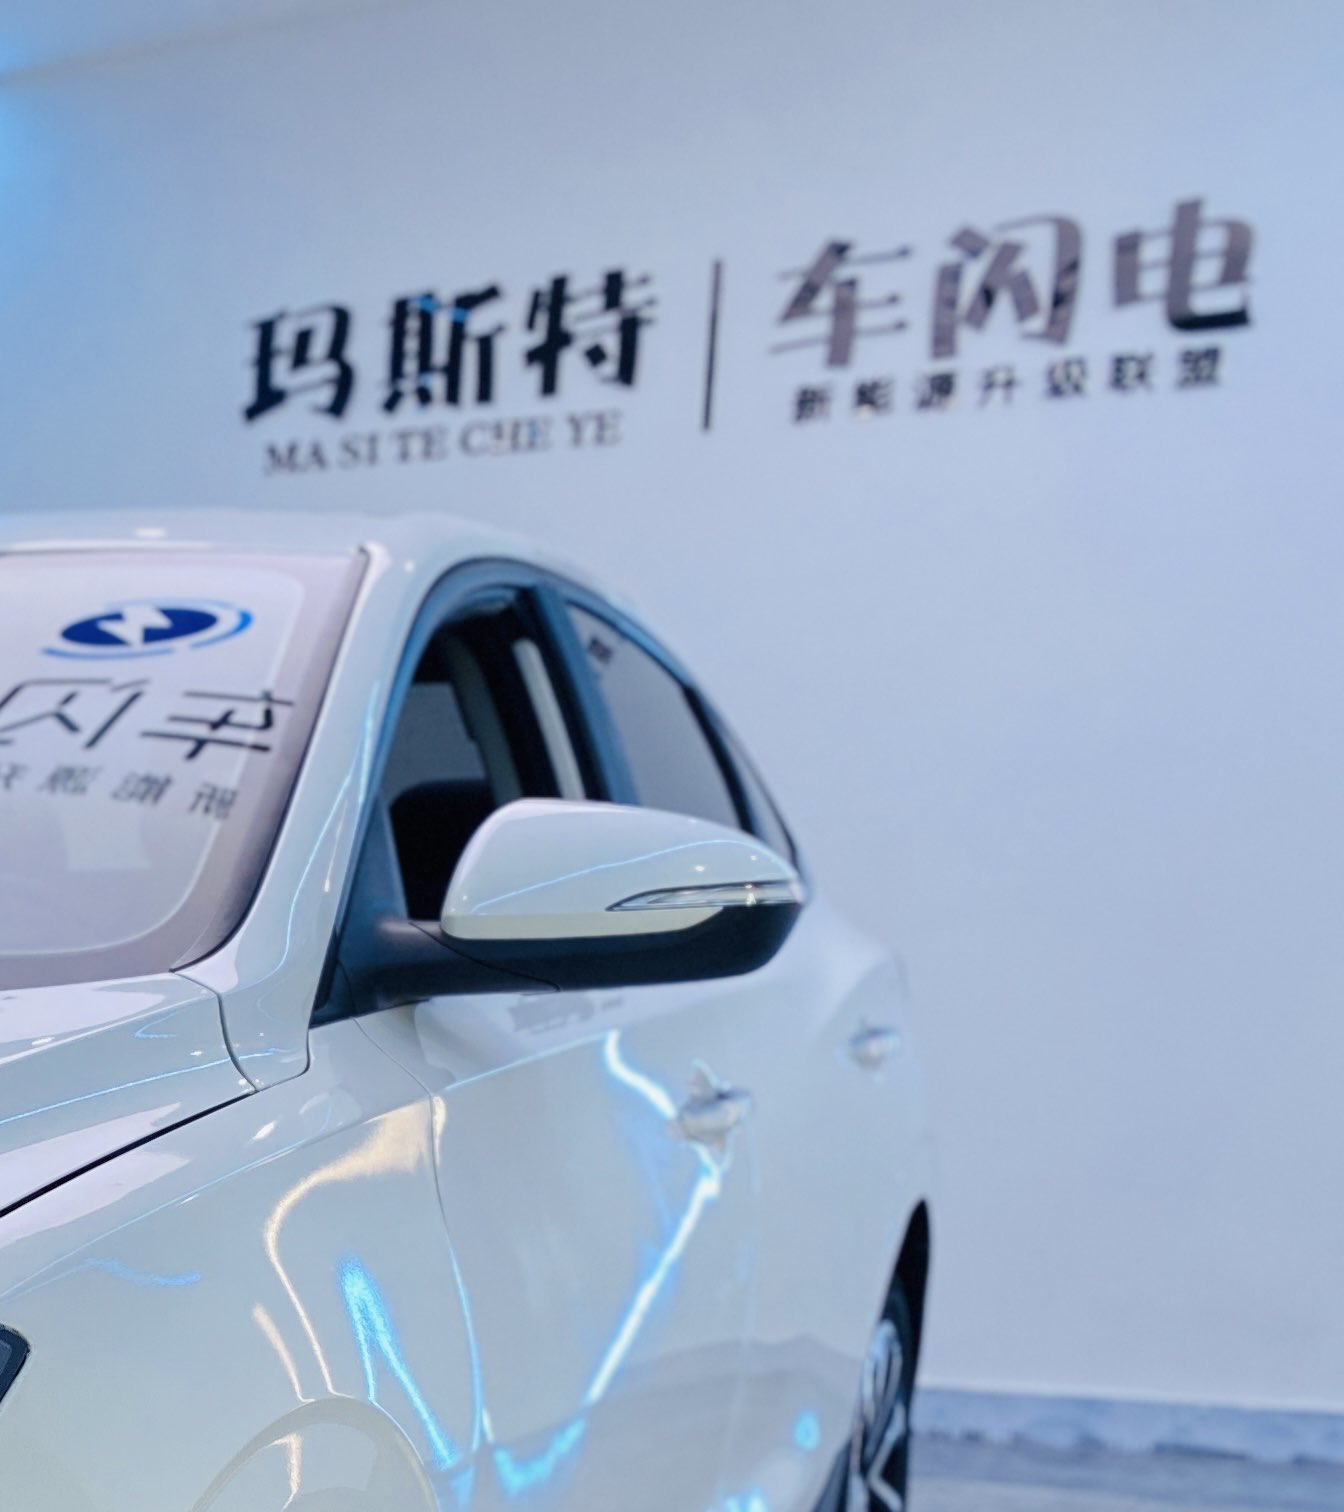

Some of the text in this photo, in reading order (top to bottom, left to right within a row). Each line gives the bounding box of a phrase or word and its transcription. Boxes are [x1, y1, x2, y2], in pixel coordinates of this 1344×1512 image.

[242, 268, 656, 422] 玛斯特
[771, 197, 1256, 368] 车闪电
[792, 345, 1224, 424] 新能源升级联盟
